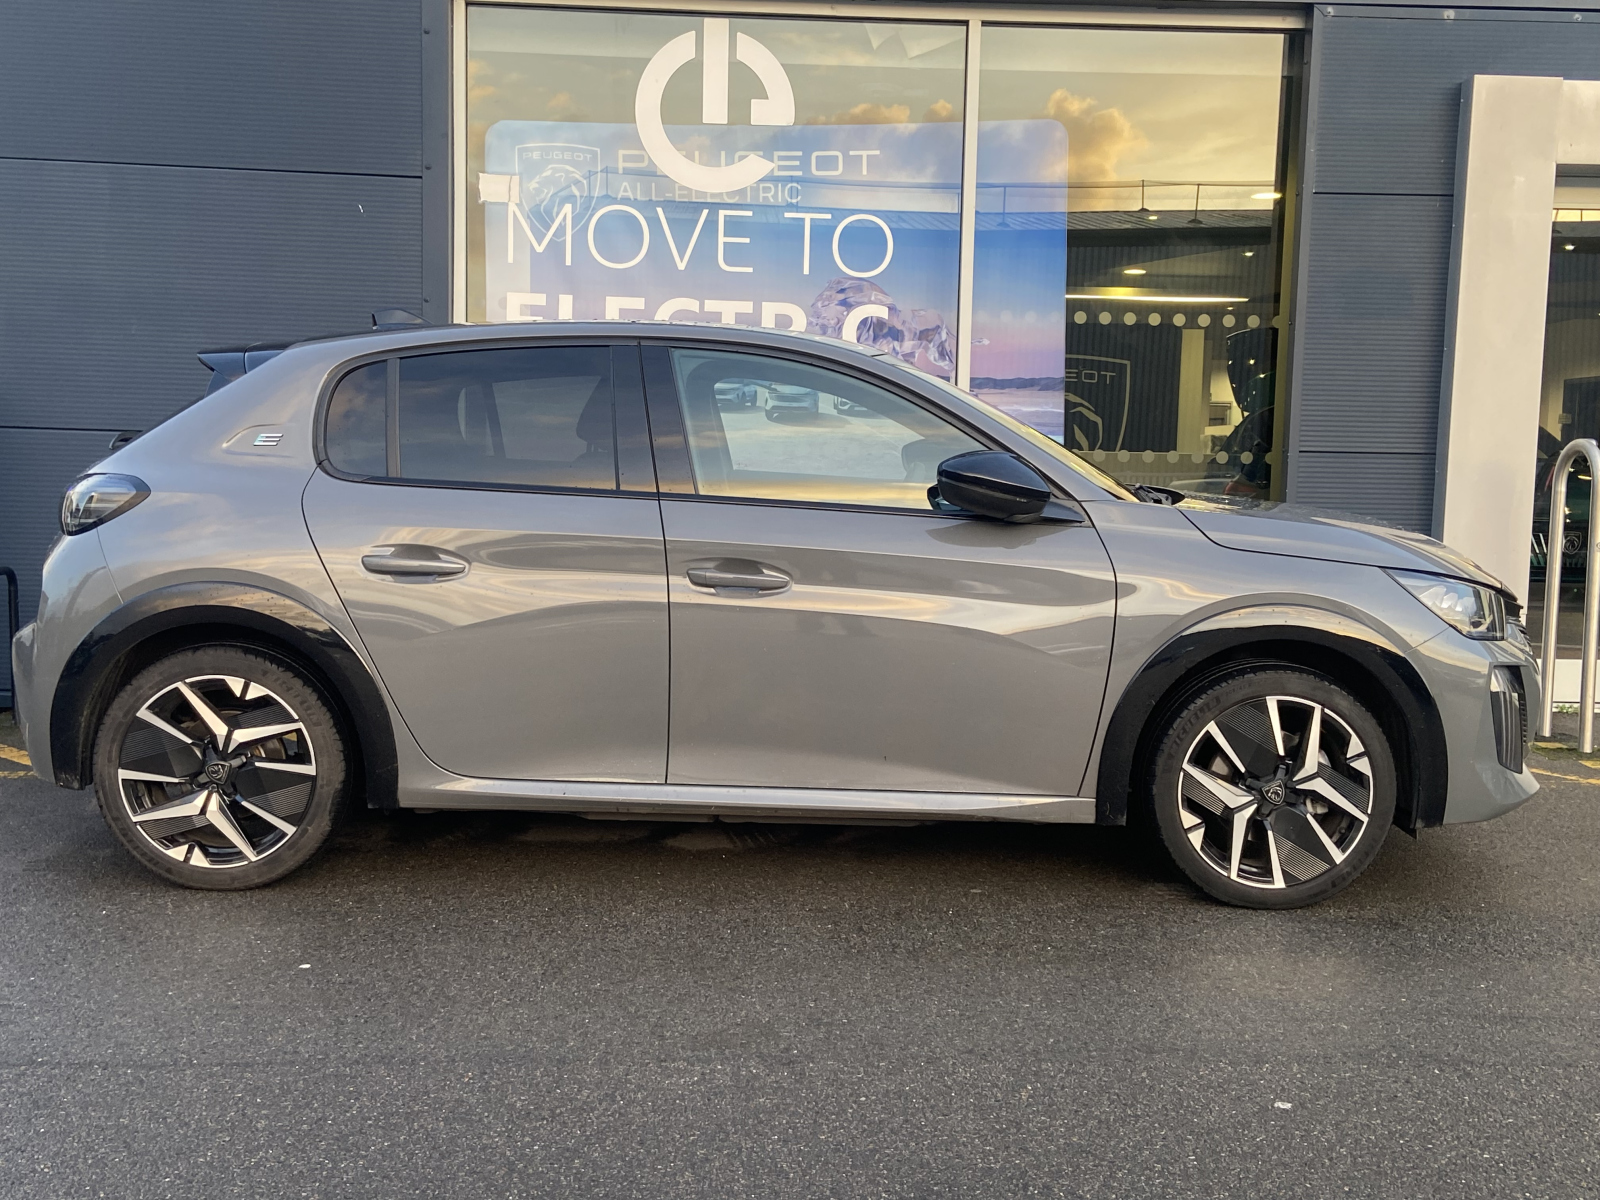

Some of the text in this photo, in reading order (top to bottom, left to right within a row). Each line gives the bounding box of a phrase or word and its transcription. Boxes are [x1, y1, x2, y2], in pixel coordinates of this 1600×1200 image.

[522, 151, 593, 162] PEUGEOT
[506, 202, 894, 279] MOVE TO
